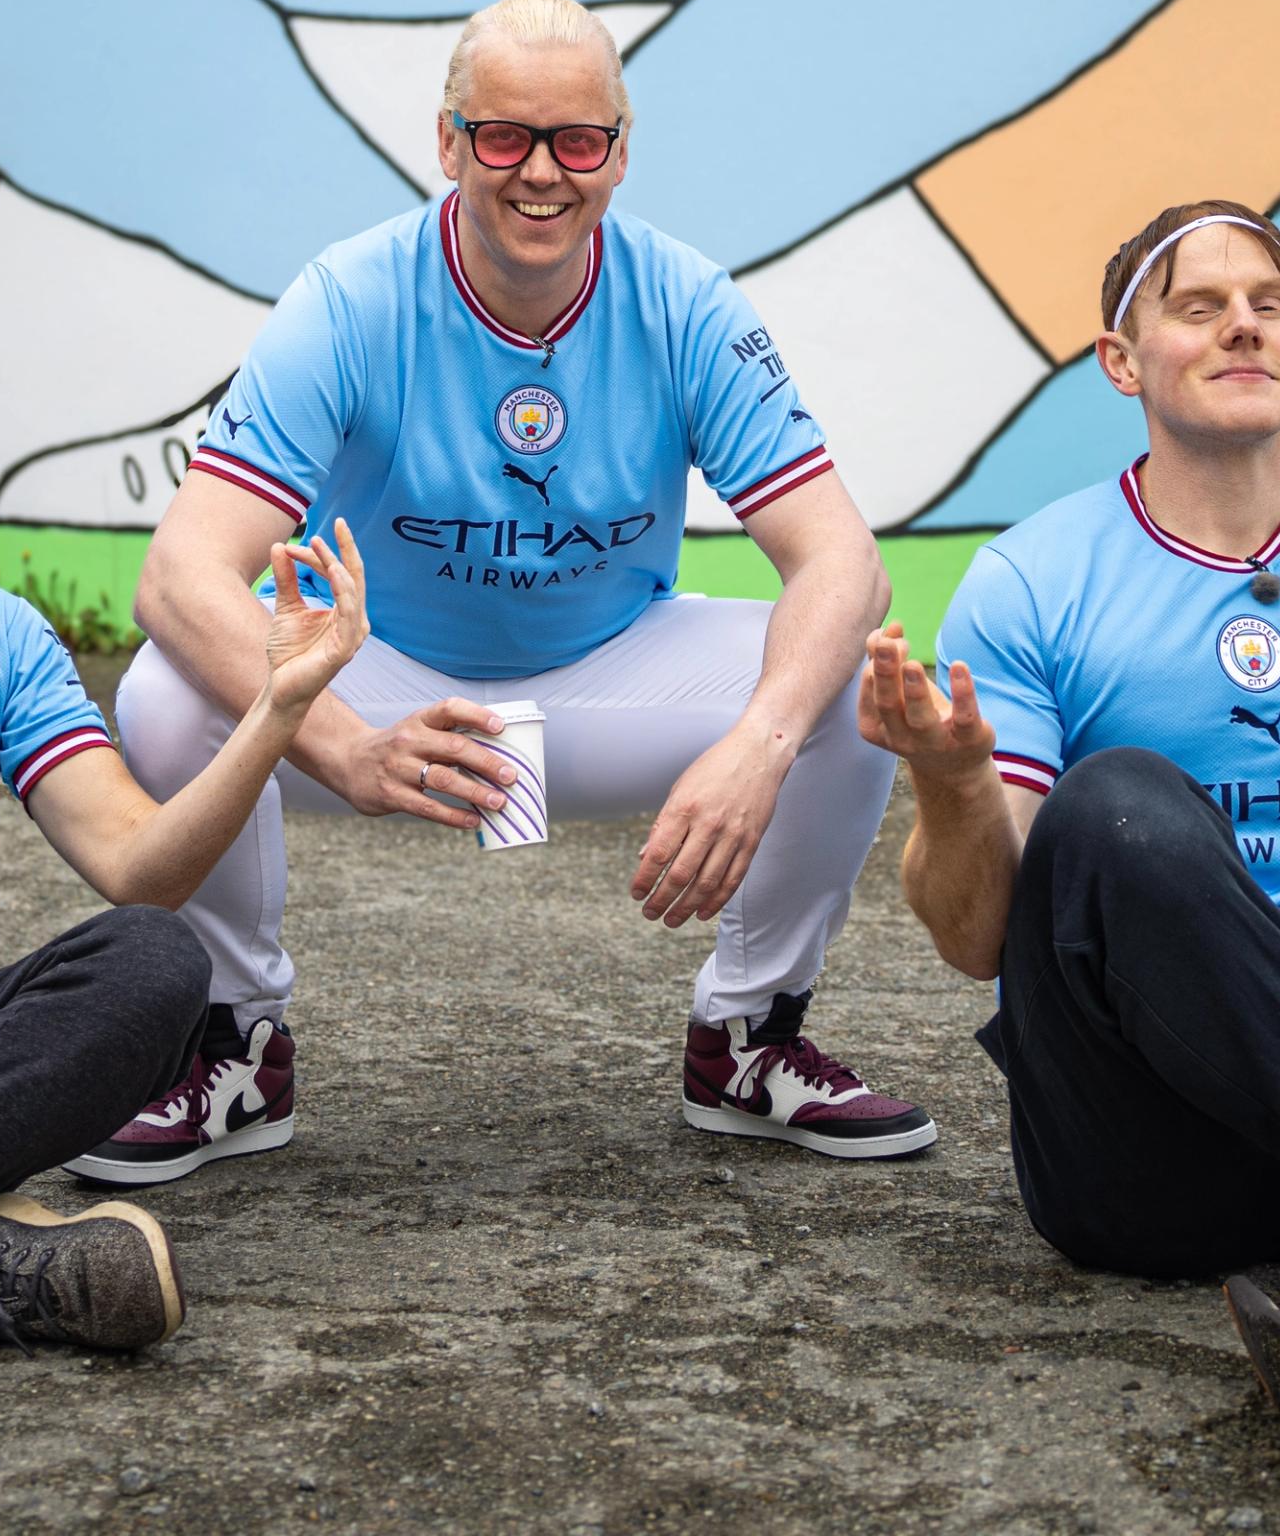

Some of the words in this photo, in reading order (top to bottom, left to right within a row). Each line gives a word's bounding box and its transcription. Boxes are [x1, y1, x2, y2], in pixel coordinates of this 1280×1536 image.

[731, 325, 774, 363] NEX
[504, 391, 559, 412] MANCHESTER
[392, 512, 656, 557] ETIHAD
[1223, 621, 1278, 645] MANCHESTER
[1248, 678, 1268, 687] CITY
